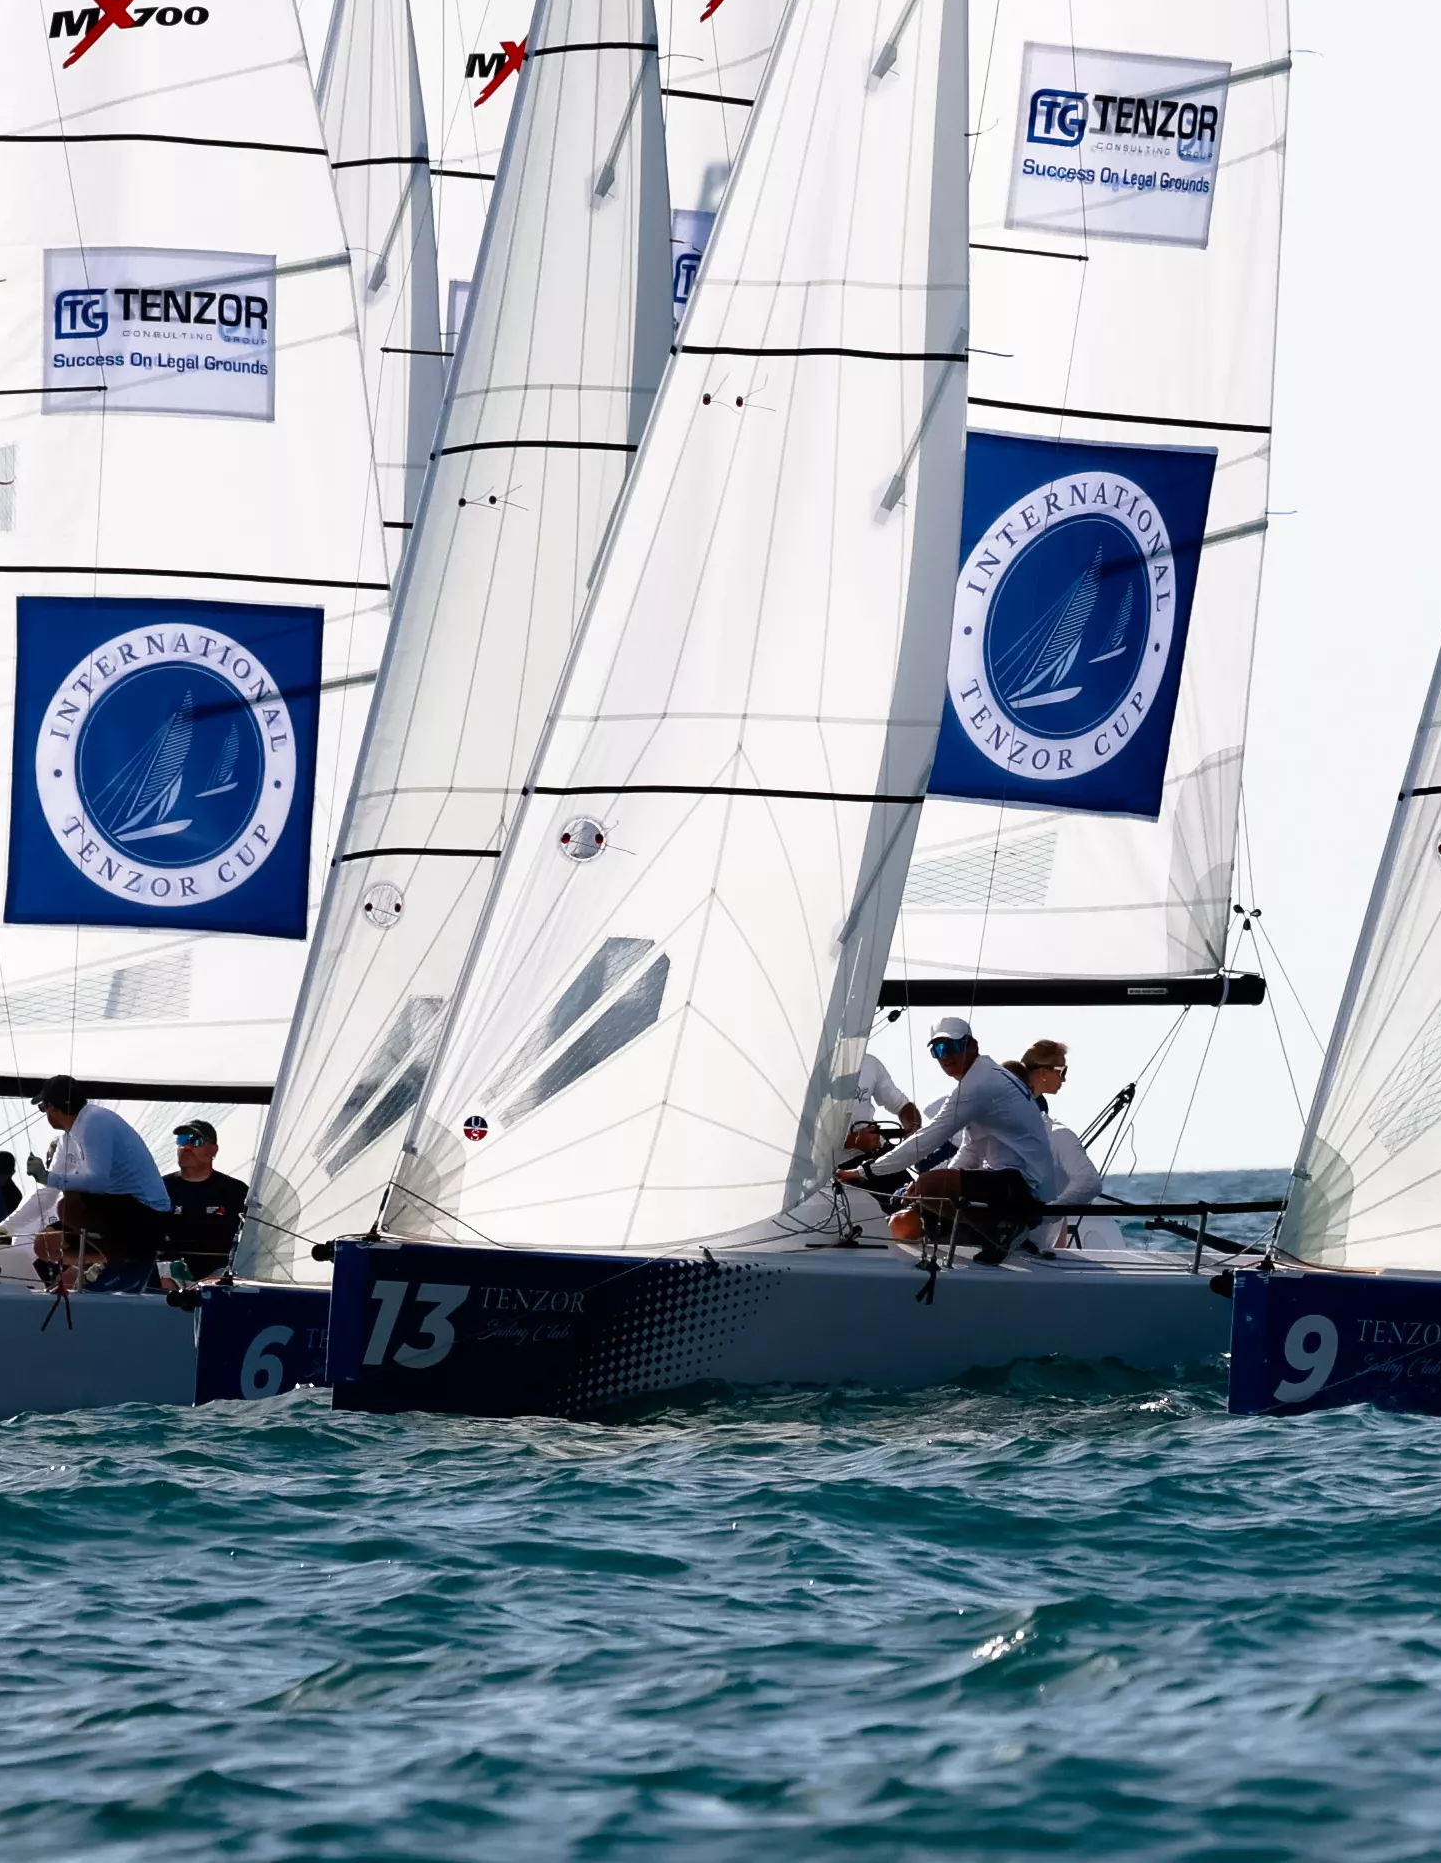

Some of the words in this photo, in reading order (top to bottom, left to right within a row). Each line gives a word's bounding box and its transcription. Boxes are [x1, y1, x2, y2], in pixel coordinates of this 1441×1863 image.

[1094, 94, 1218, 142] TENZOR
[1096, 142, 1171, 156] CONSULTING
[1022, 158, 1095, 182] Success
[1100, 167, 1119, 185] On
[1123, 169, 1156, 191] Legal
[1160, 172, 1210, 193] Grounds
[114, 288, 268, 330] TENZOR
[123, 329, 213, 341] CONSULTING
[53, 353, 124, 368] Success
[130, 352, 152, 367] On
[158, 352, 199, 372] Legal
[204, 355, 268, 375] Grounds
[966, 481, 1169, 613] INTERNATIONAL
[51, 630, 287, 753] INTERNATIONAL
[959, 678, 1075, 772] TENZOR
[1093, 690, 1144, 758] CUP
[62, 816, 197, 899] TENZOR
[218, 822, 271, 885] CUP
[362, 1280, 471, 1369] 13
[480, 1286, 585, 1314] TENZOR
[1273, 1314, 1339, 1403] 9
[240, 1325, 295, 1400] 6
